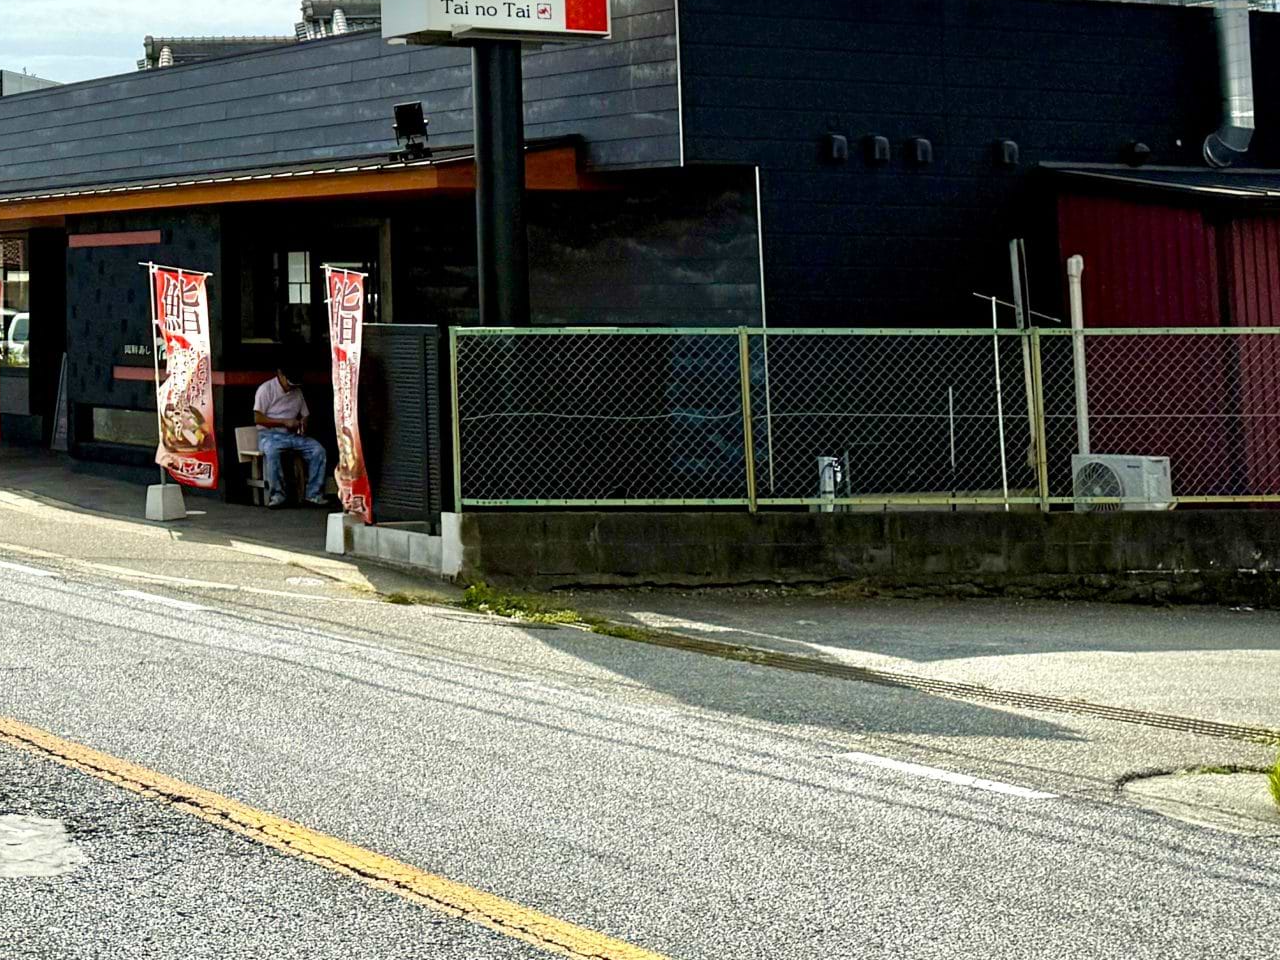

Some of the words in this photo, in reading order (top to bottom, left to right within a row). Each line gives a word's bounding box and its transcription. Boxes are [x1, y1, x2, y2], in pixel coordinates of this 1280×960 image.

[475, 5, 498, 17] no
[502, 2, 531, 18] Tai
[163, 274, 201, 335] 鮨
